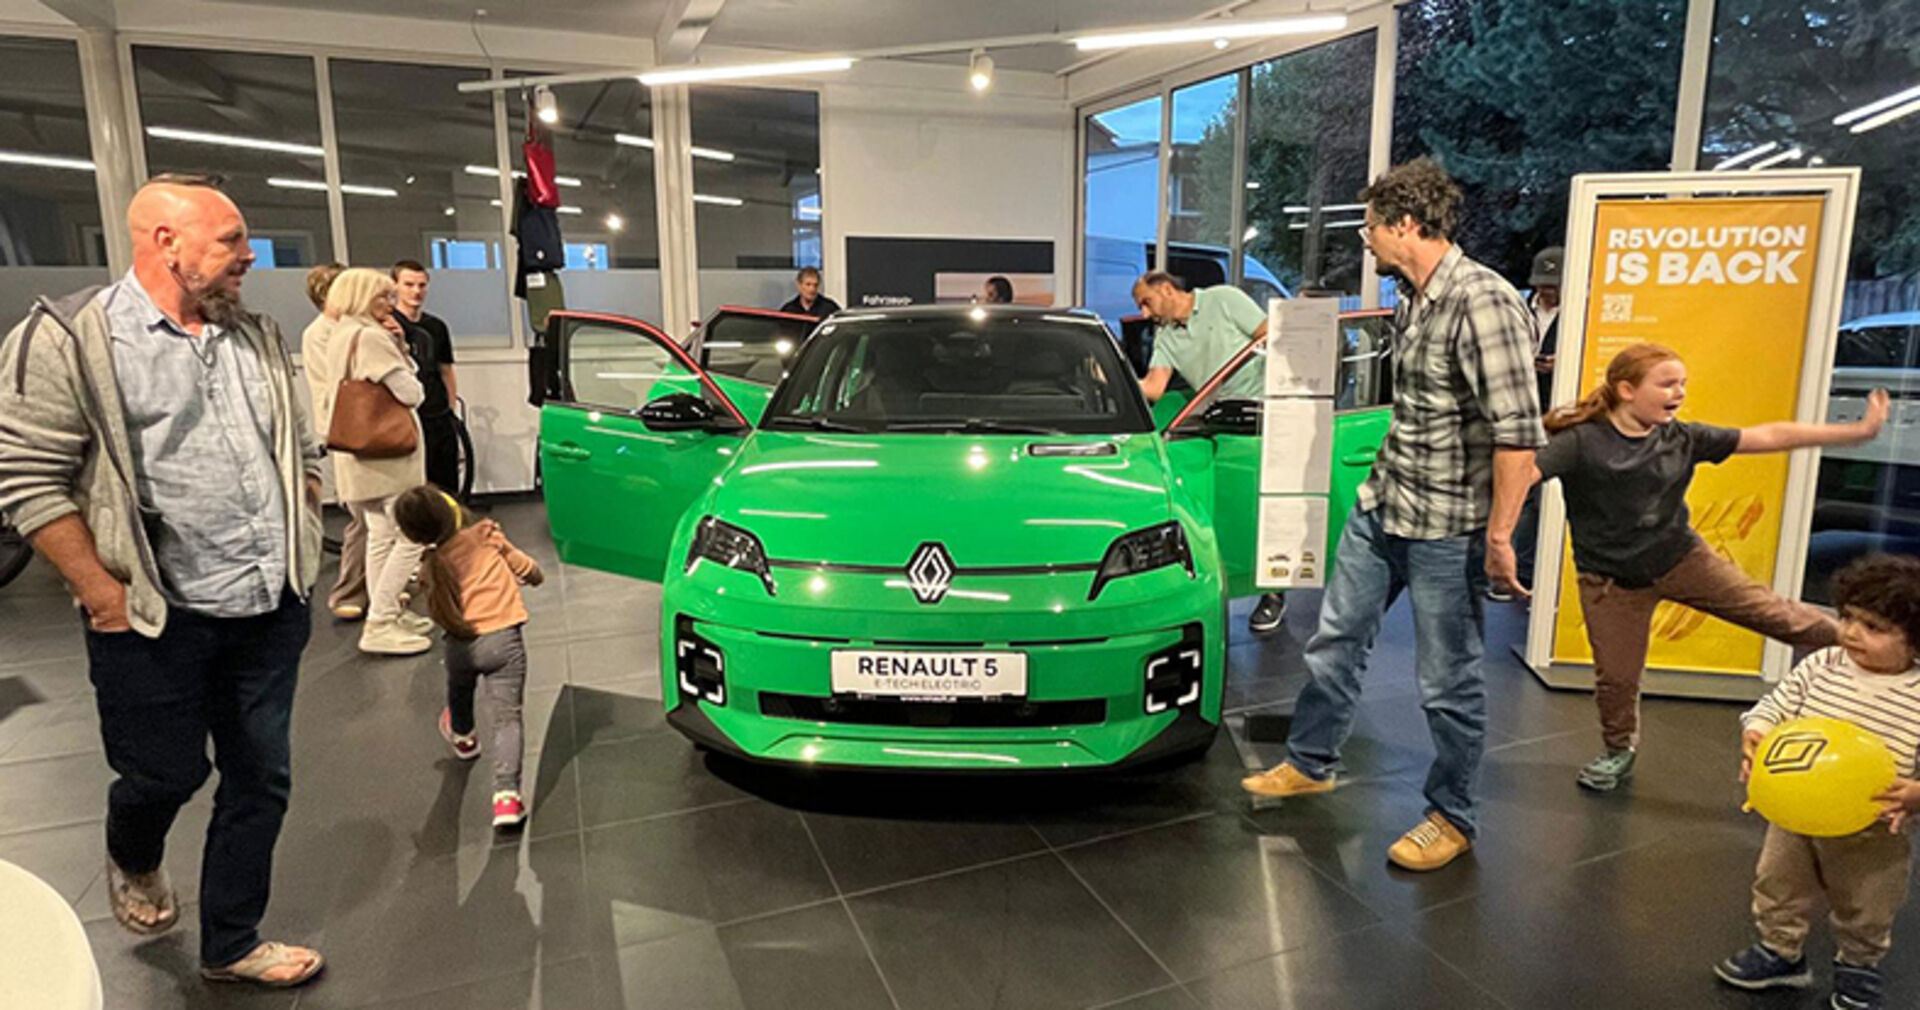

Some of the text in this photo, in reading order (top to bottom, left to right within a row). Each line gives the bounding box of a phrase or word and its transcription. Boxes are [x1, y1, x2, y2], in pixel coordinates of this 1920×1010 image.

[1608, 226, 1806, 249] R5VOLUTION
[1604, 250, 1805, 285] IS BACK
[858, 657, 998, 677] RENAULT 5
